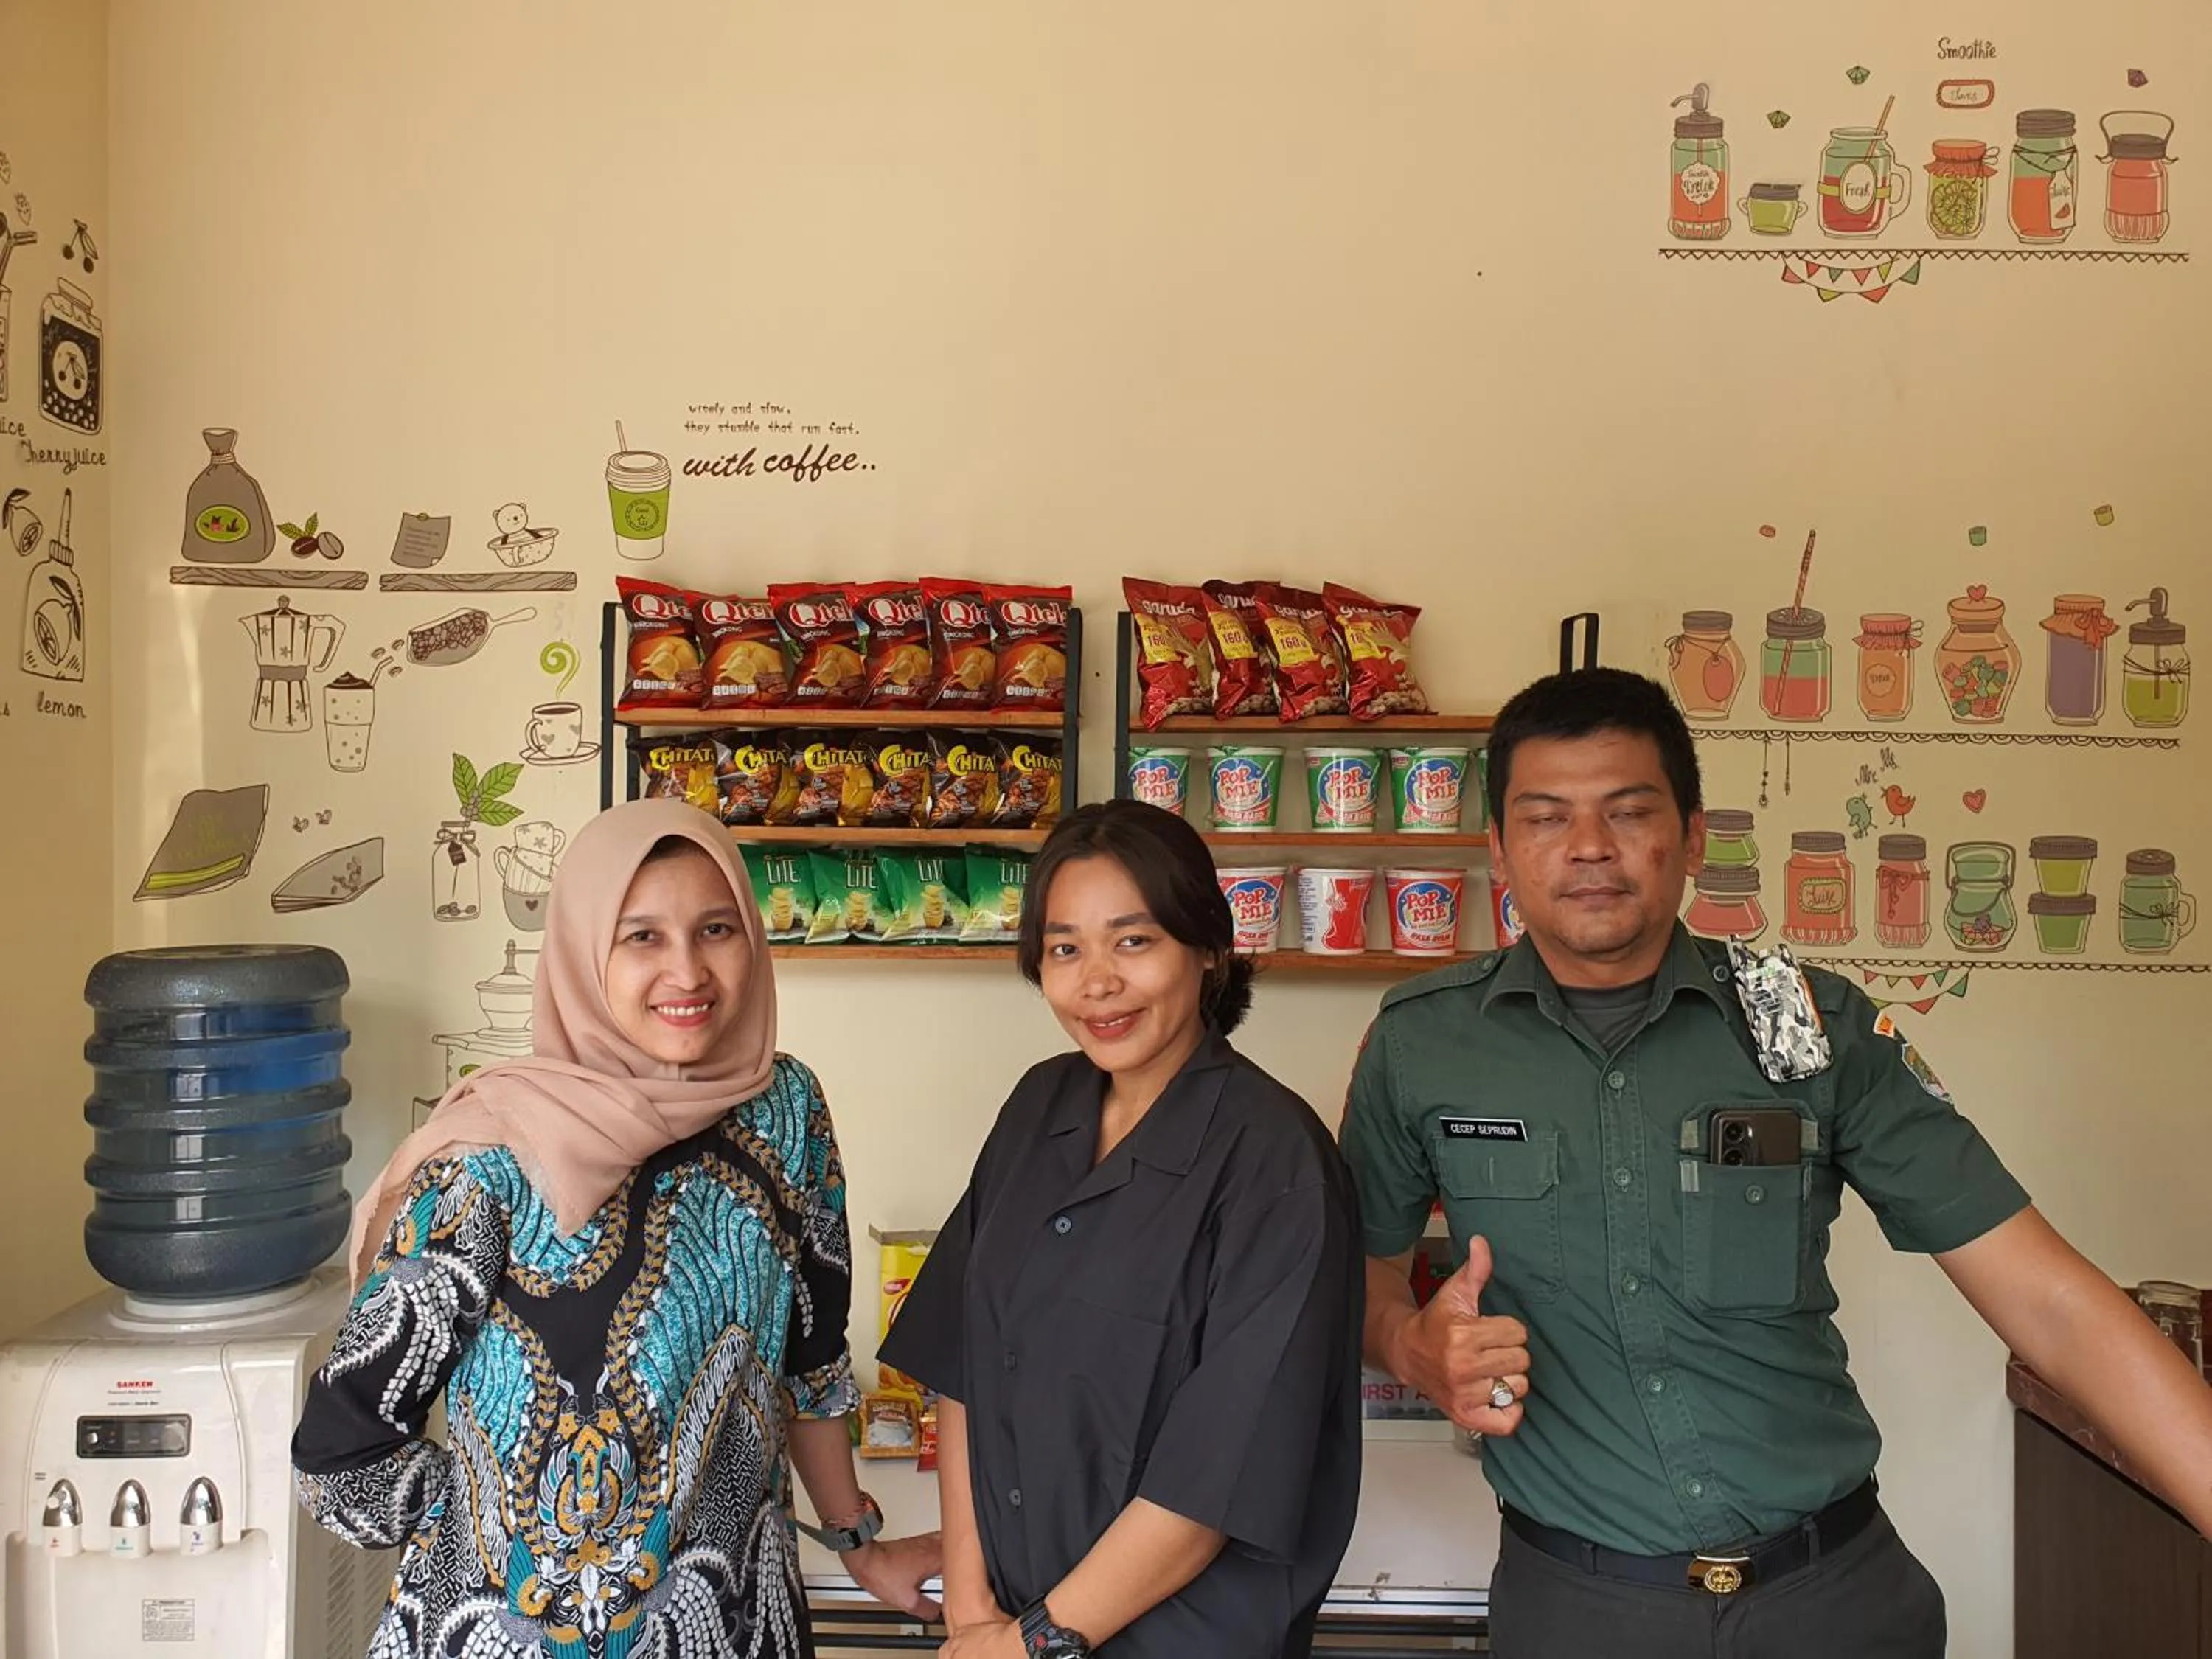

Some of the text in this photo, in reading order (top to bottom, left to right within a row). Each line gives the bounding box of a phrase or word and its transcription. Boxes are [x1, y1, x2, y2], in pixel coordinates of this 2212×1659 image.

[1937, 36, 1997, 60] Smoothie
[731, 402, 751, 414] and
[684, 420, 710, 435] they
[768, 420, 793, 434] that
[801, 425, 821, 434] run
[683, 447, 757, 477] with
[632, 594, 694, 620] Qte
[702, 599, 776, 625] Qtel
[789, 598, 855, 627] Qtel
[868, 595, 922, 626] Qtel
[940, 599, 991, 628] Qte
[37, 690, 87, 719] lemon
[734, 745, 787, 774] CHITA
[879, 744, 930, 776] CHITA
[947, 745, 995, 776] CHITA
[1012, 745, 1062, 773] CHITAT
[1135, 767, 1169, 785] POP
[1220, 768, 1251, 785] POP
[1328, 768, 1362, 785] POP
[1416, 768, 1451, 786] POP
[1143, 782, 1177, 798] MIE
[1226, 782, 1259, 798] MIE
[1426, 782, 1456, 799] MIE
[918, 860, 943, 882] LIT
[1234, 889, 1266, 907] POP
[1407, 892, 1440, 910] POP
[1240, 904, 1273, 920] MIE
[1413, 905, 1447, 922] MIE
[1450, 1123, 1475, 1133] CECEP
[1363, 1383, 1408, 1401] IRST
